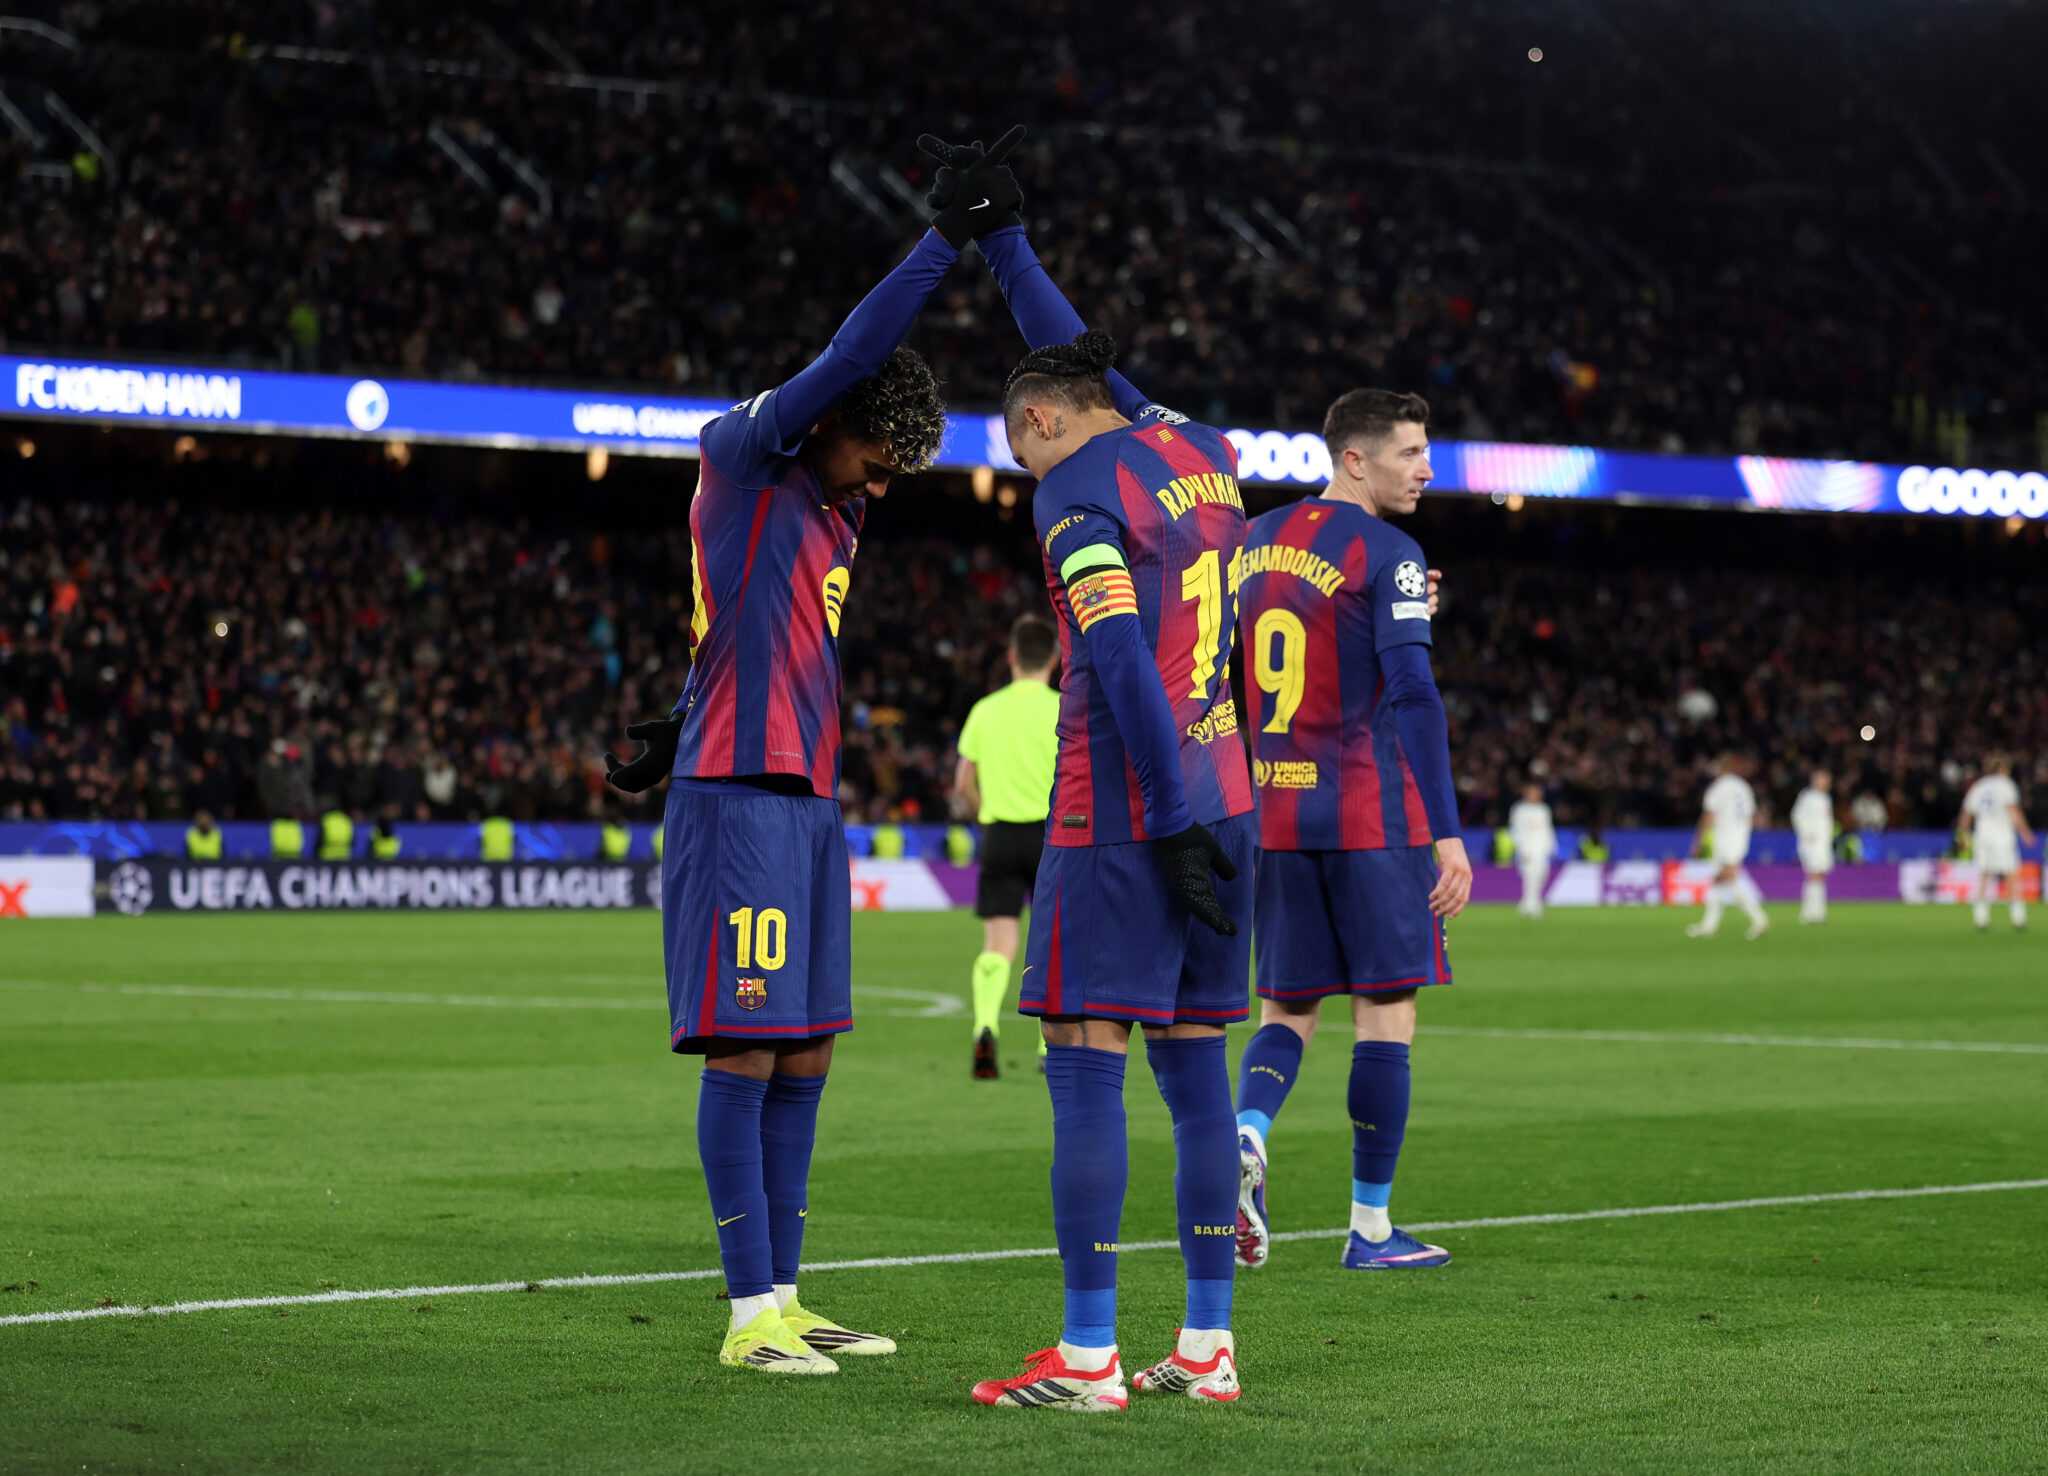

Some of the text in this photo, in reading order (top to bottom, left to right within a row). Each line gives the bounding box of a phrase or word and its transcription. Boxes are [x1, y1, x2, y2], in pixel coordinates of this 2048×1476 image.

[572, 402, 637, 437] UEFA
[1896, 464, 2048, 519] GOOOO
[1253, 607, 1307, 734] 9
[1272, 773, 1318, 784] ACNUR
[168, 865, 636, 909] UEFA CHAMPIONS LEAGUE
[729, 907, 787, 971] 10
[1094, 1242, 1118, 1253] BAR
[1193, 1225, 1236, 1236] BARÇA
